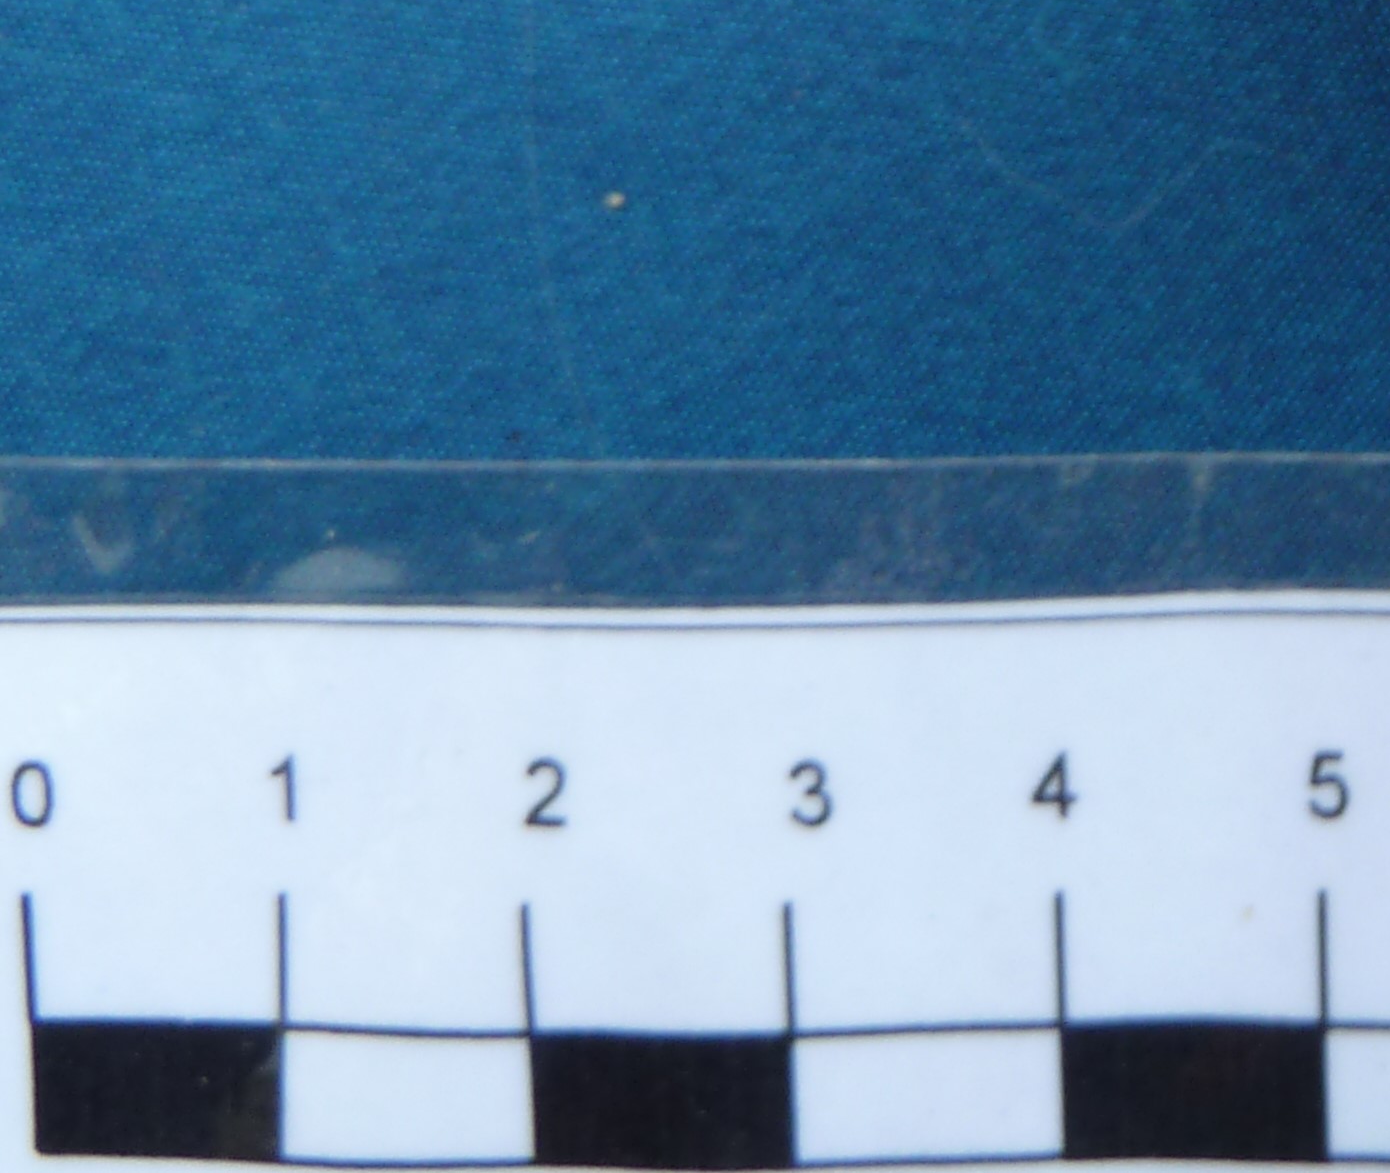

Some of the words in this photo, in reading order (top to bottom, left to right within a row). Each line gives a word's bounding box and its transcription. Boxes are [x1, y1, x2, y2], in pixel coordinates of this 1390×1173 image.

[11, 763, 52, 827] 0
[273, 760, 293, 819] 1
[526, 760, 563, 827] 2
[791, 762, 830, 827] 3
[1032, 755, 1074, 816] 4
[1310, 752, 1348, 819] 5
